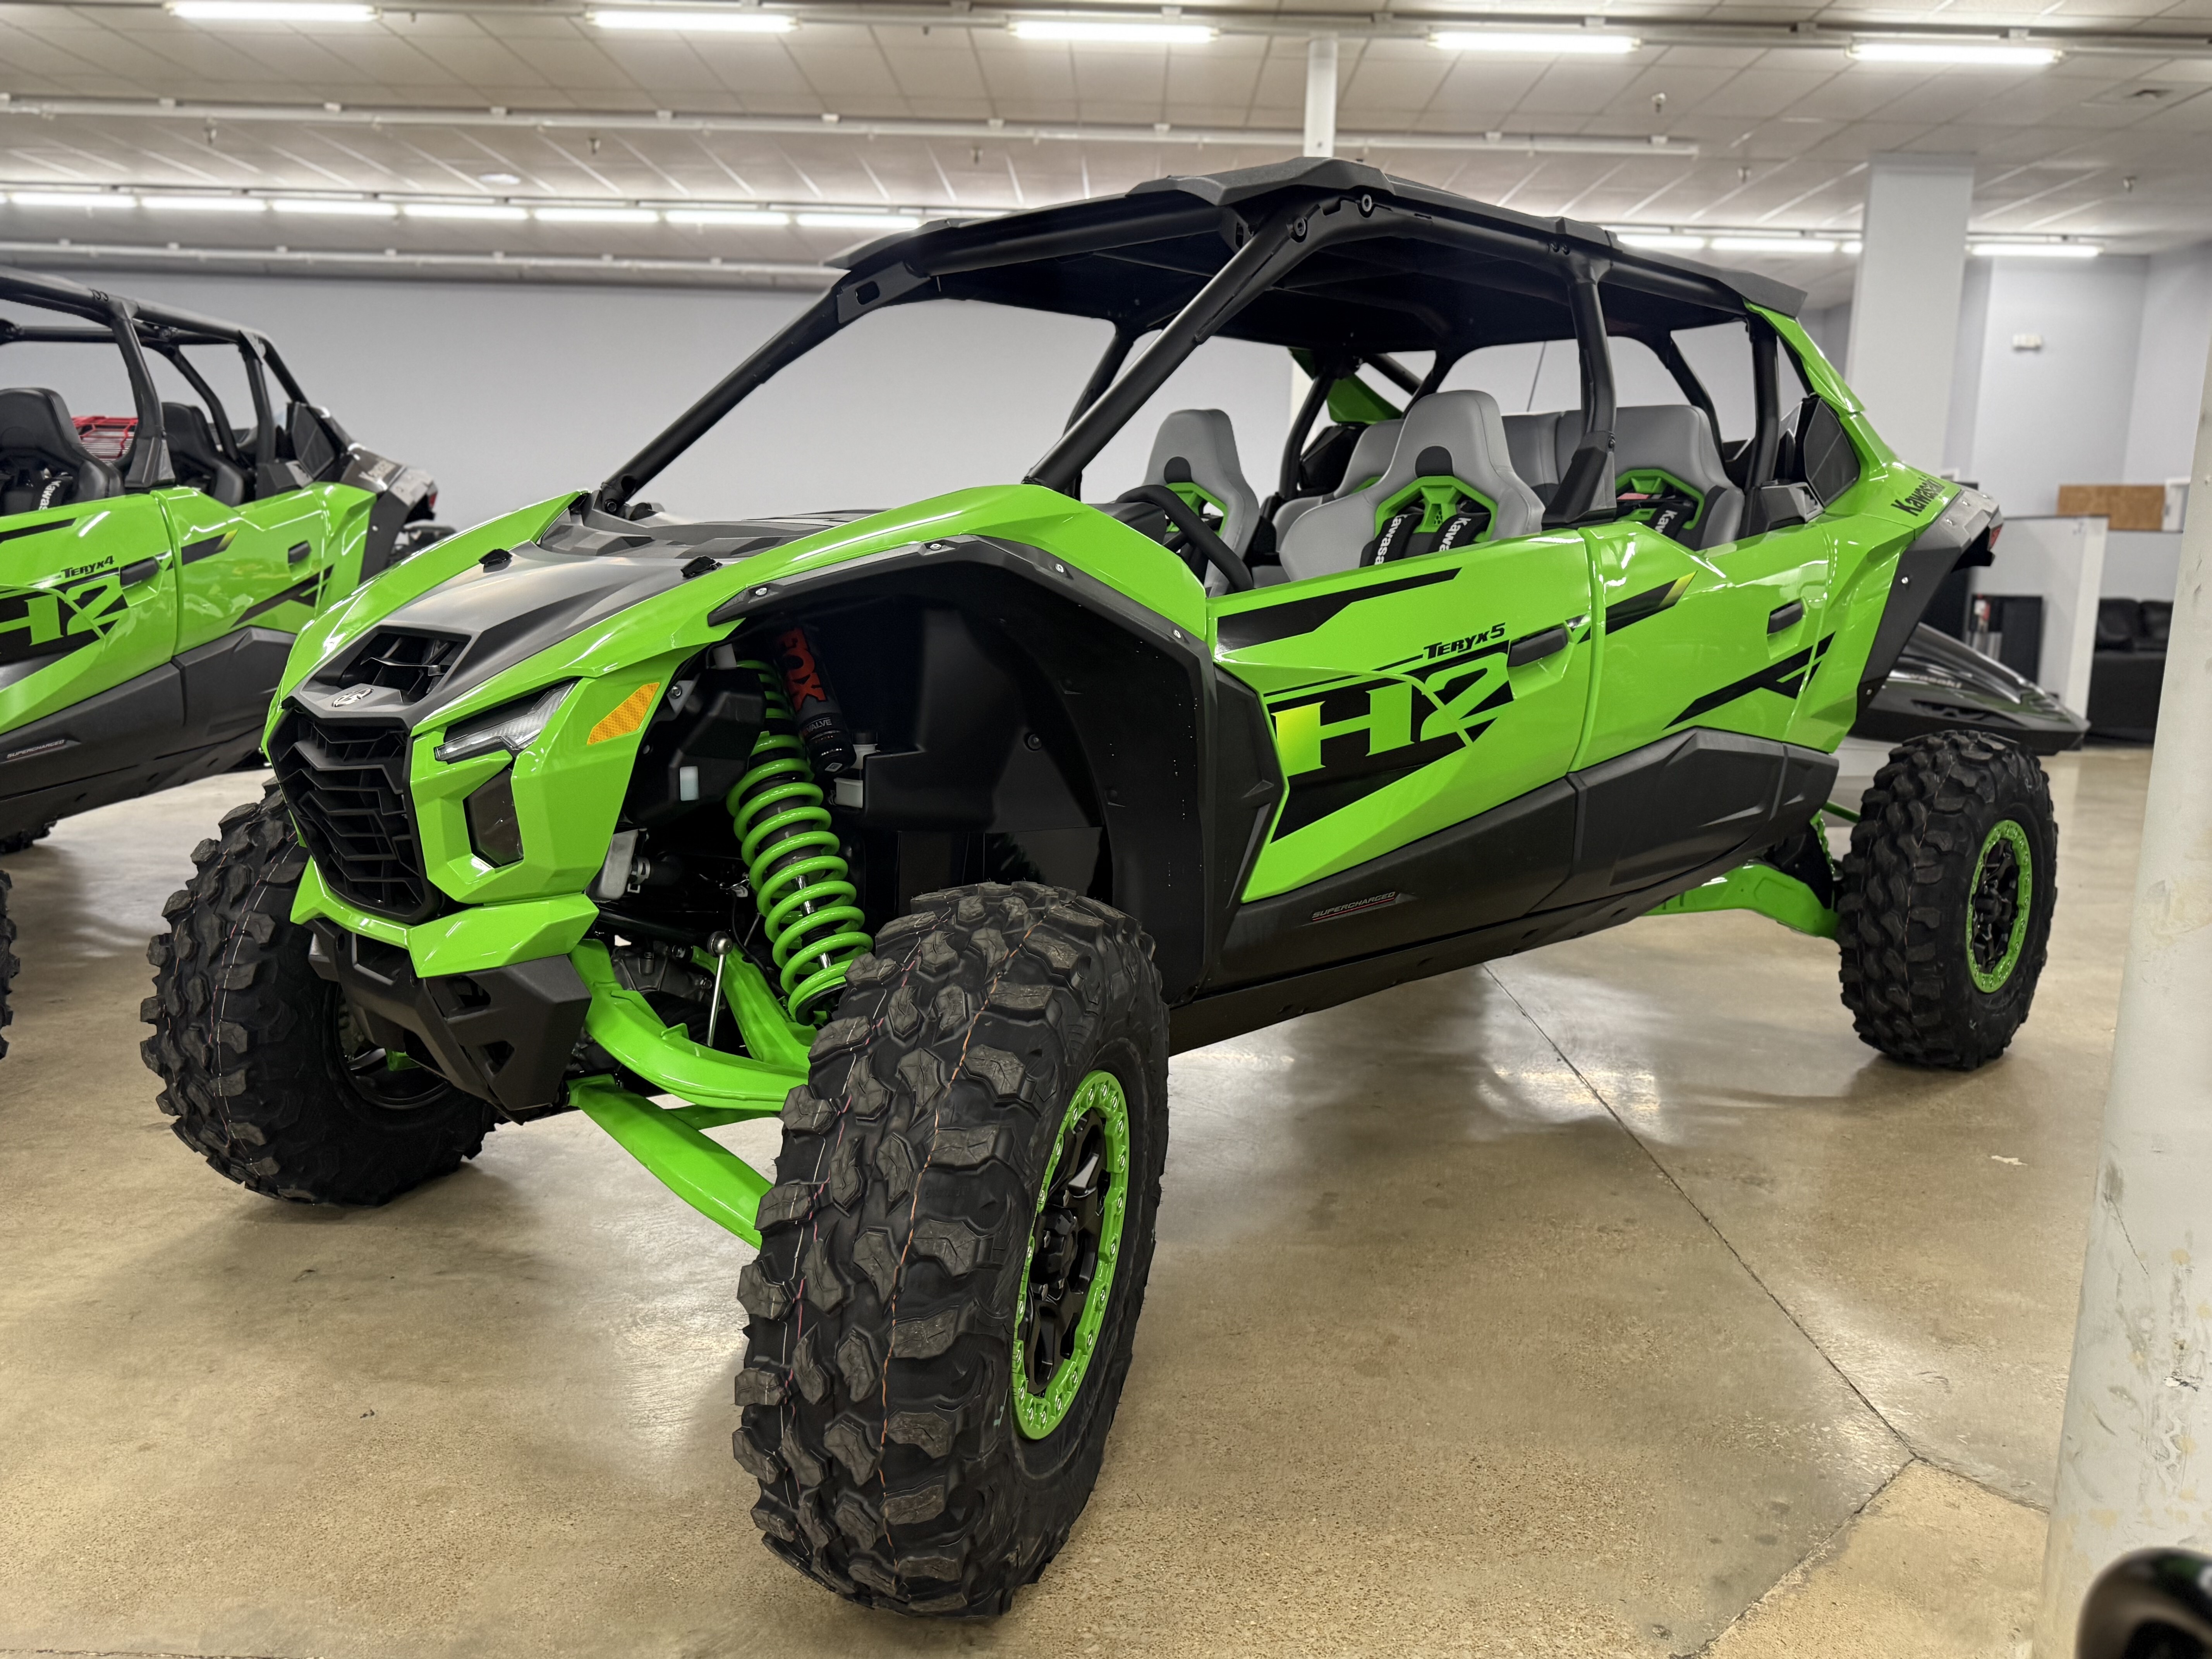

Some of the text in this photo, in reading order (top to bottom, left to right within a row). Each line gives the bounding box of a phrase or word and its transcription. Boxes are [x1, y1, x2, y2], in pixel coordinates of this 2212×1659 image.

[1891, 475, 1945, 517] Kawasaki
[778, 628, 826, 712] FOX
[1271, 652, 1514, 777] H2
[7, 739, 65, 758] SUPERCHARGED
[1312, 891, 1395, 918] SUPERCHARGED
